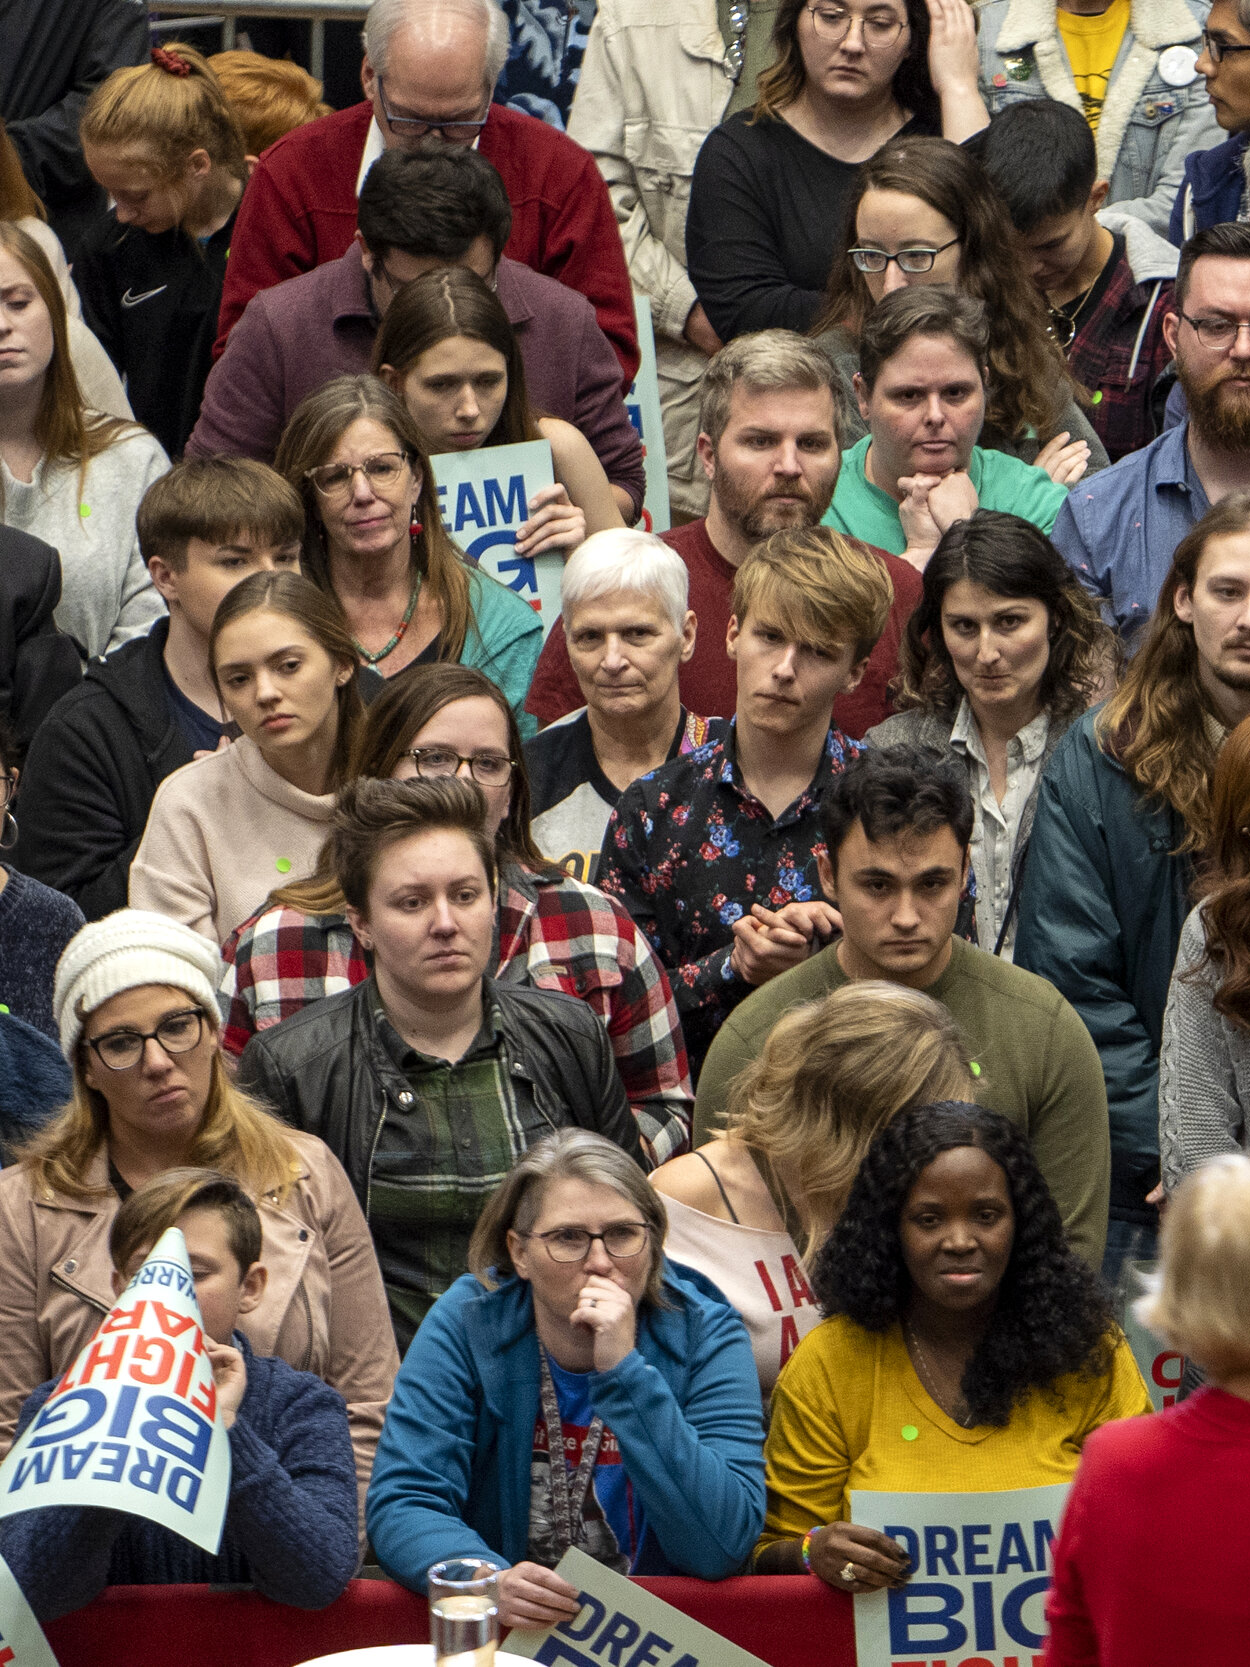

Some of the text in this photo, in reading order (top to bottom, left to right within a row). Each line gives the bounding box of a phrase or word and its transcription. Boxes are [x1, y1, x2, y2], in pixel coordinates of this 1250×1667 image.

[754, 1259, 783, 1312] I
[26, 1384, 213, 1474] BIG
[7, 1441, 203, 1515] DREAM
